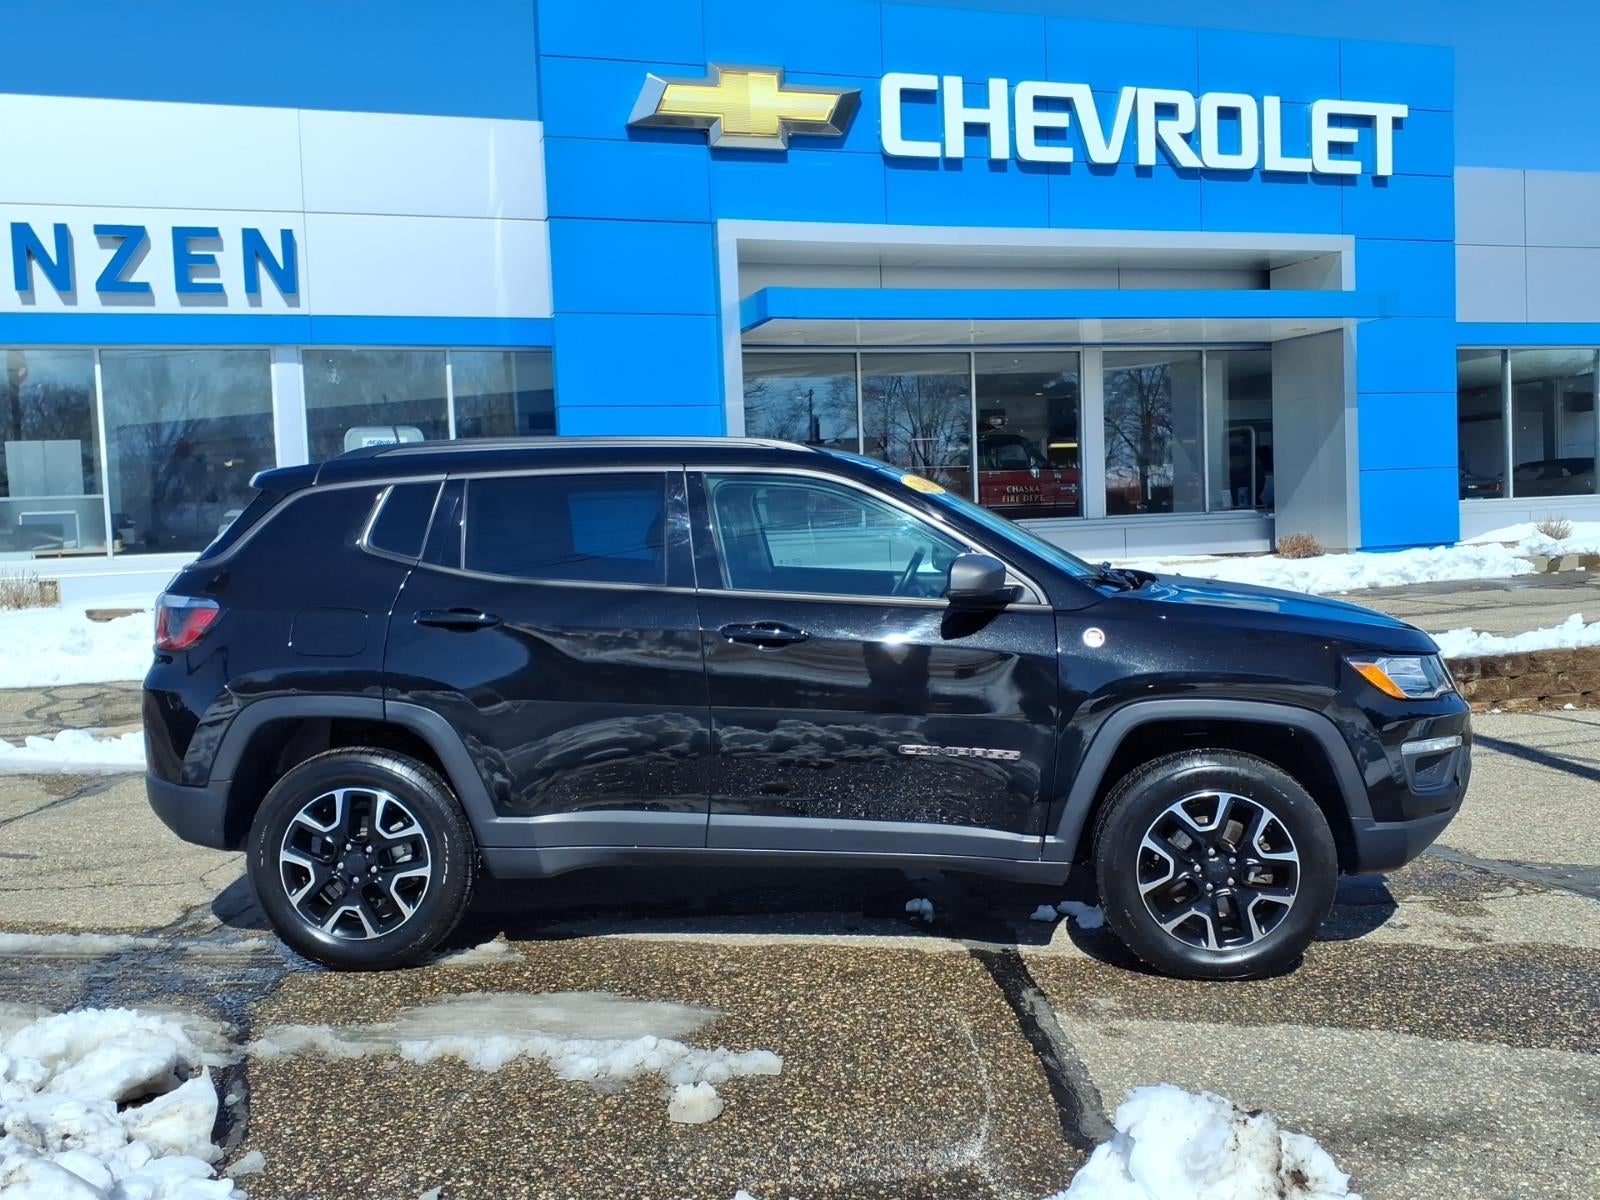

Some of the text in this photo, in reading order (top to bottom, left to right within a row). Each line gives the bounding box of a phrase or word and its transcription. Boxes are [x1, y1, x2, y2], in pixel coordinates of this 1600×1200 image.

[879, 72, 1409, 177] CHEVROLET
[10, 221, 297, 295] NZEN
[1006, 485, 1041, 493] CHASKA
[1002, 495, 1020, 503] FIRE
[899, 744, 1021, 760] COMPASS
